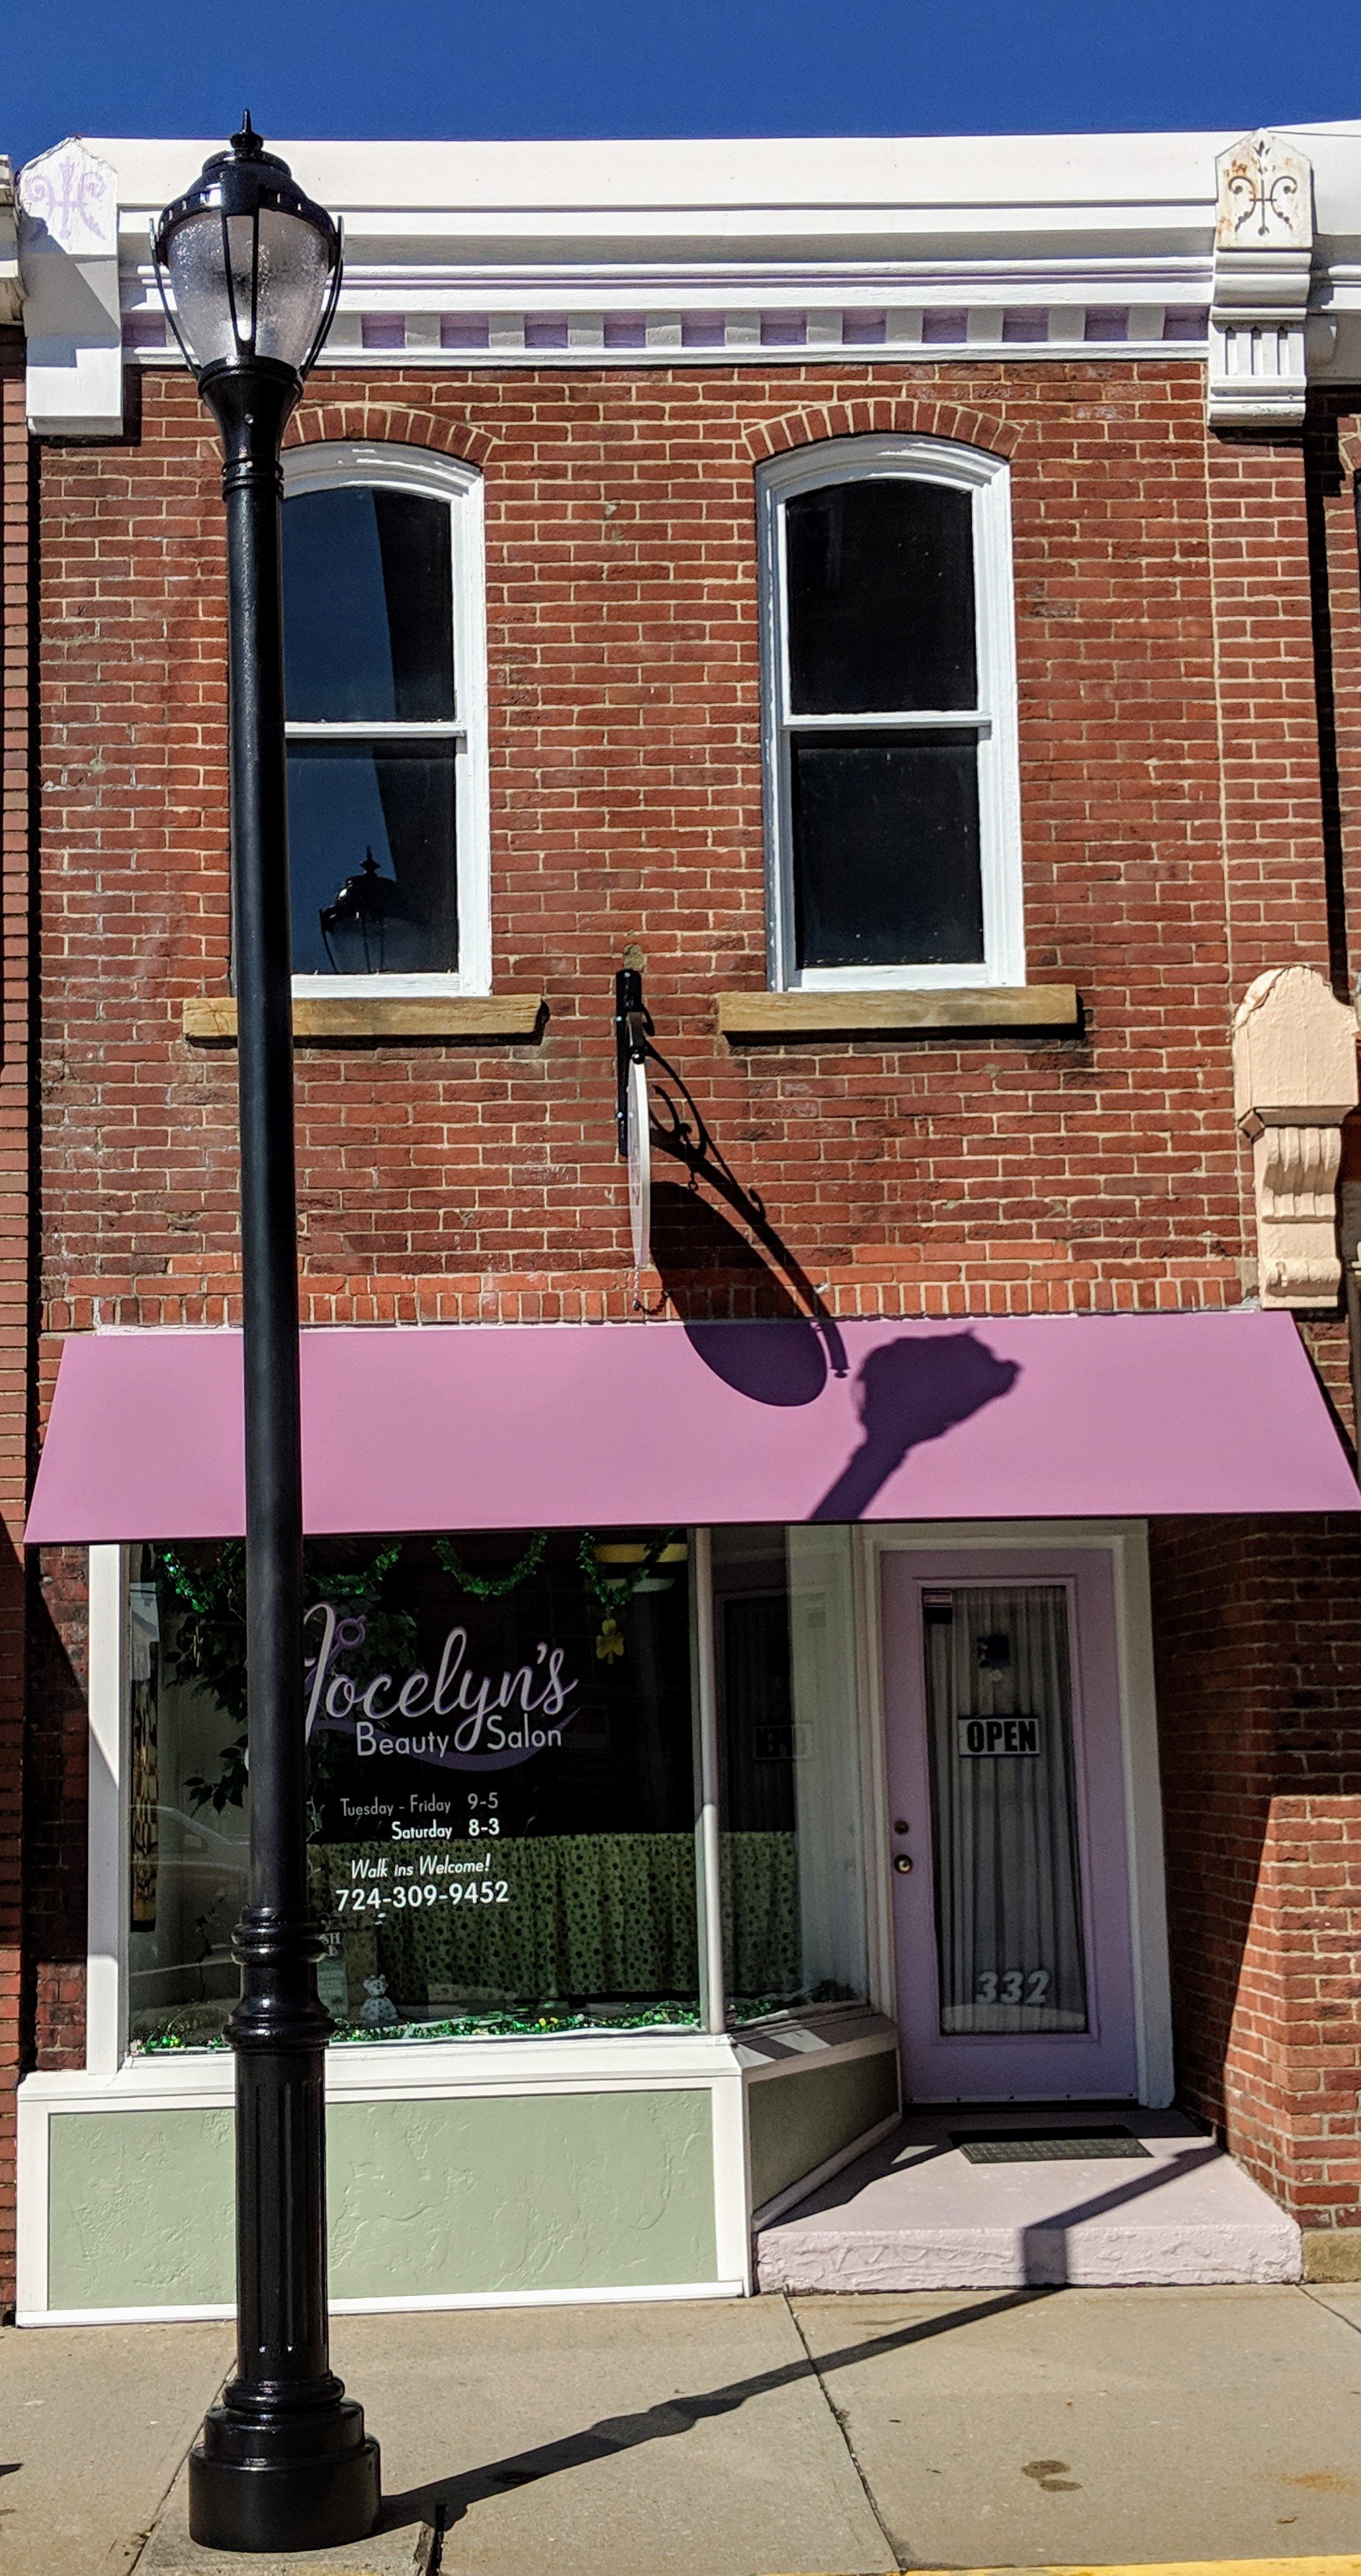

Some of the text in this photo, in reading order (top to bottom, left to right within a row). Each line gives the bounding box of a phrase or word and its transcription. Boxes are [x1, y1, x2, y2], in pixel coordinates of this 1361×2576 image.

[356, 1713, 562, 1757] Beauty Salon
[967, 1721, 1036, 1753] OPEN
[340, 1796, 394, 1817] Tuesday
[410, 1793, 451, 1814] Friday
[467, 1792, 498, 1810] 9-5
[392, 1817, 500, 1840] Saturday 8-3
[351, 1853, 490, 1879] Walk ins Welcome!
[336, 1880, 509, 1911] 724-309-9452
[975, 1970, 1050, 2003] 332
